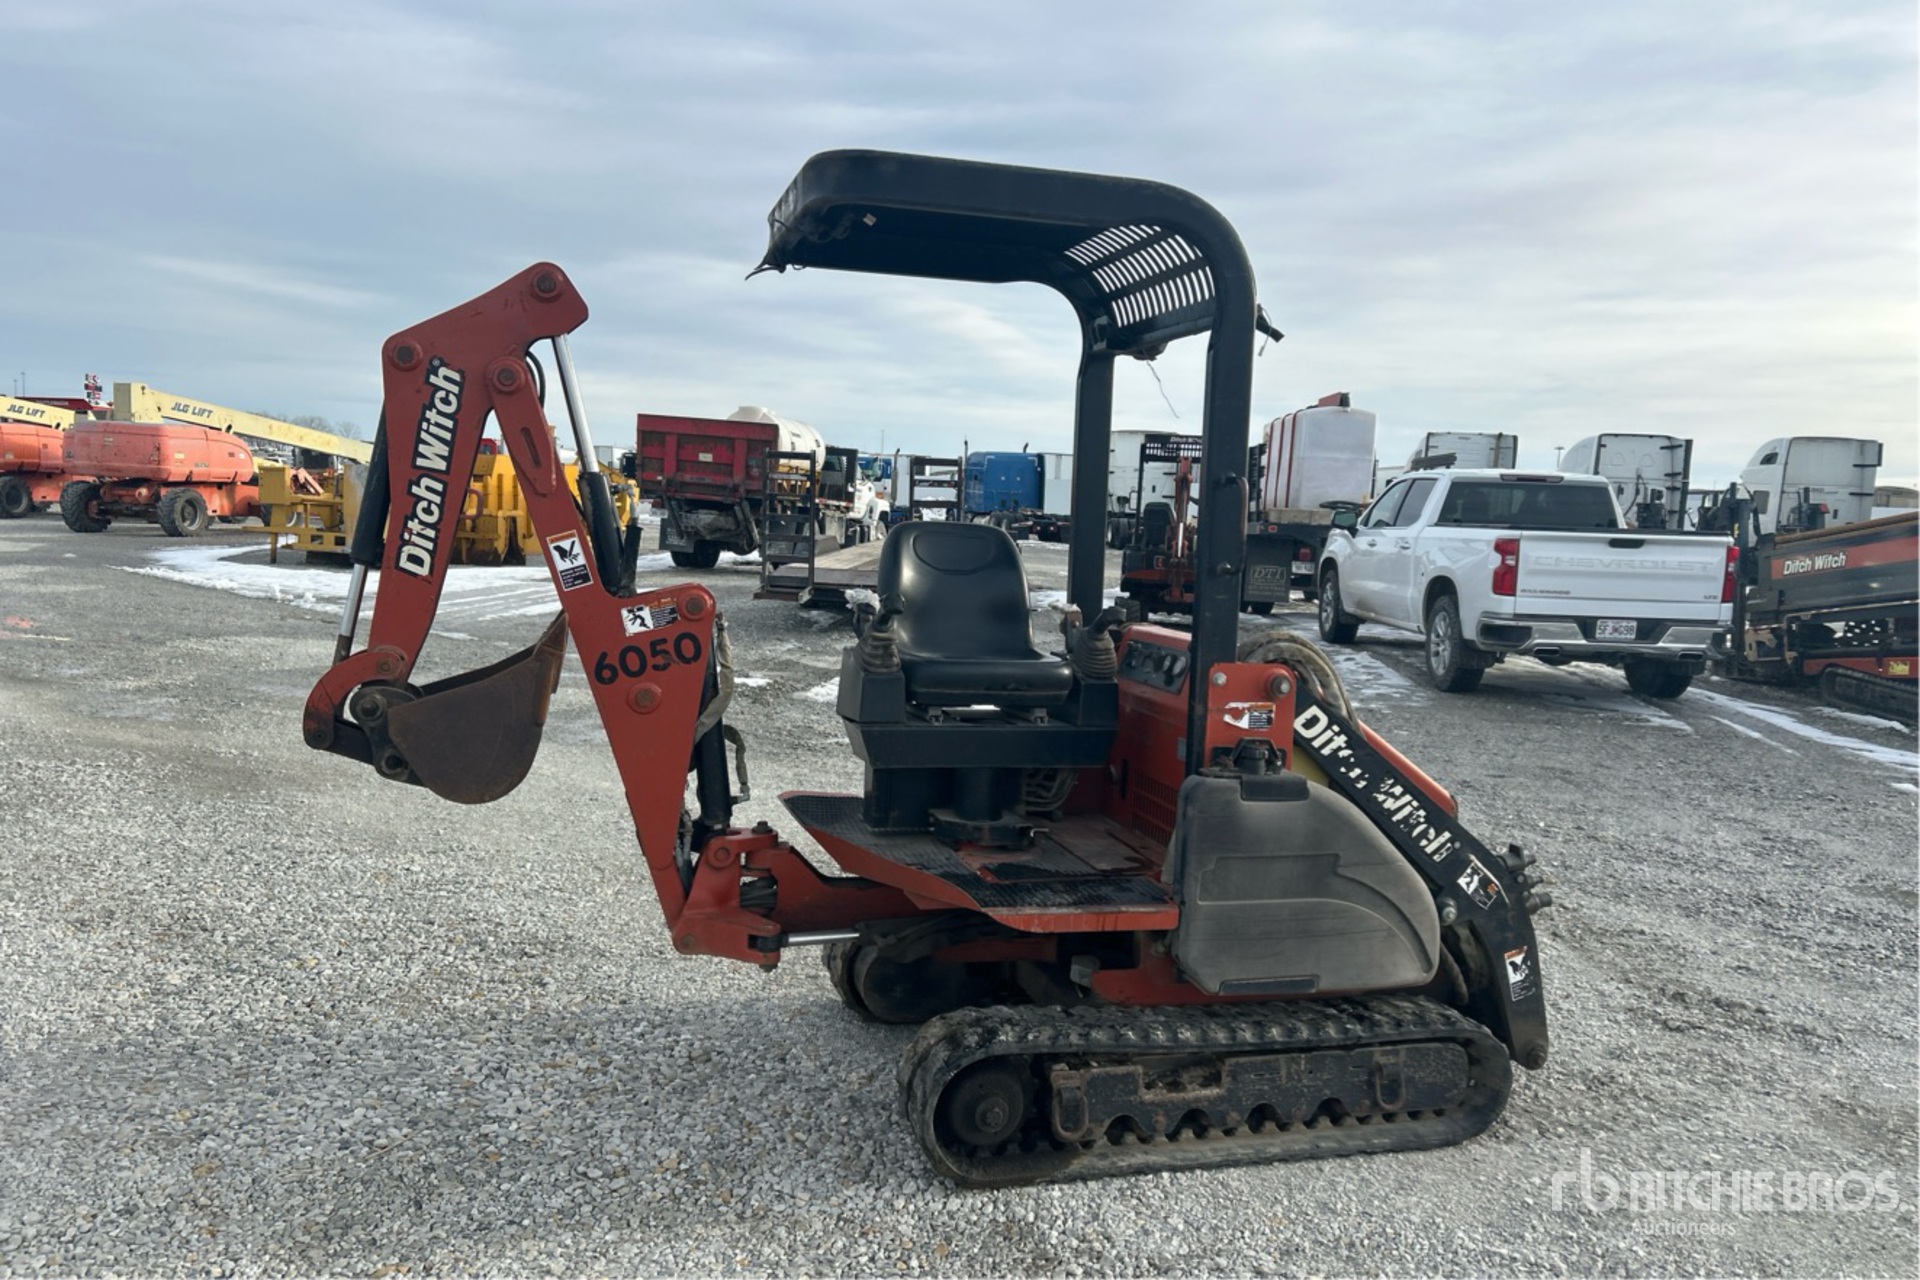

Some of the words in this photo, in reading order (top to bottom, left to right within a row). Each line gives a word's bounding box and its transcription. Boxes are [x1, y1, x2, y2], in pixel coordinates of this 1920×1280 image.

[7, 404, 24, 415] JLG
[25, 407, 46, 419] LIFT
[171, 402, 190, 414] JLG
[191, 406, 214, 419] LIFT
[417, 365, 462, 473] Witch
[399, 477, 444, 578] Ditch
[1534, 556, 1714, 573] CHEVROLET
[1783, 558, 1812, 575] Ditch
[1814, 552, 1847, 571] Witch
[594, 632, 702, 686] 6050
